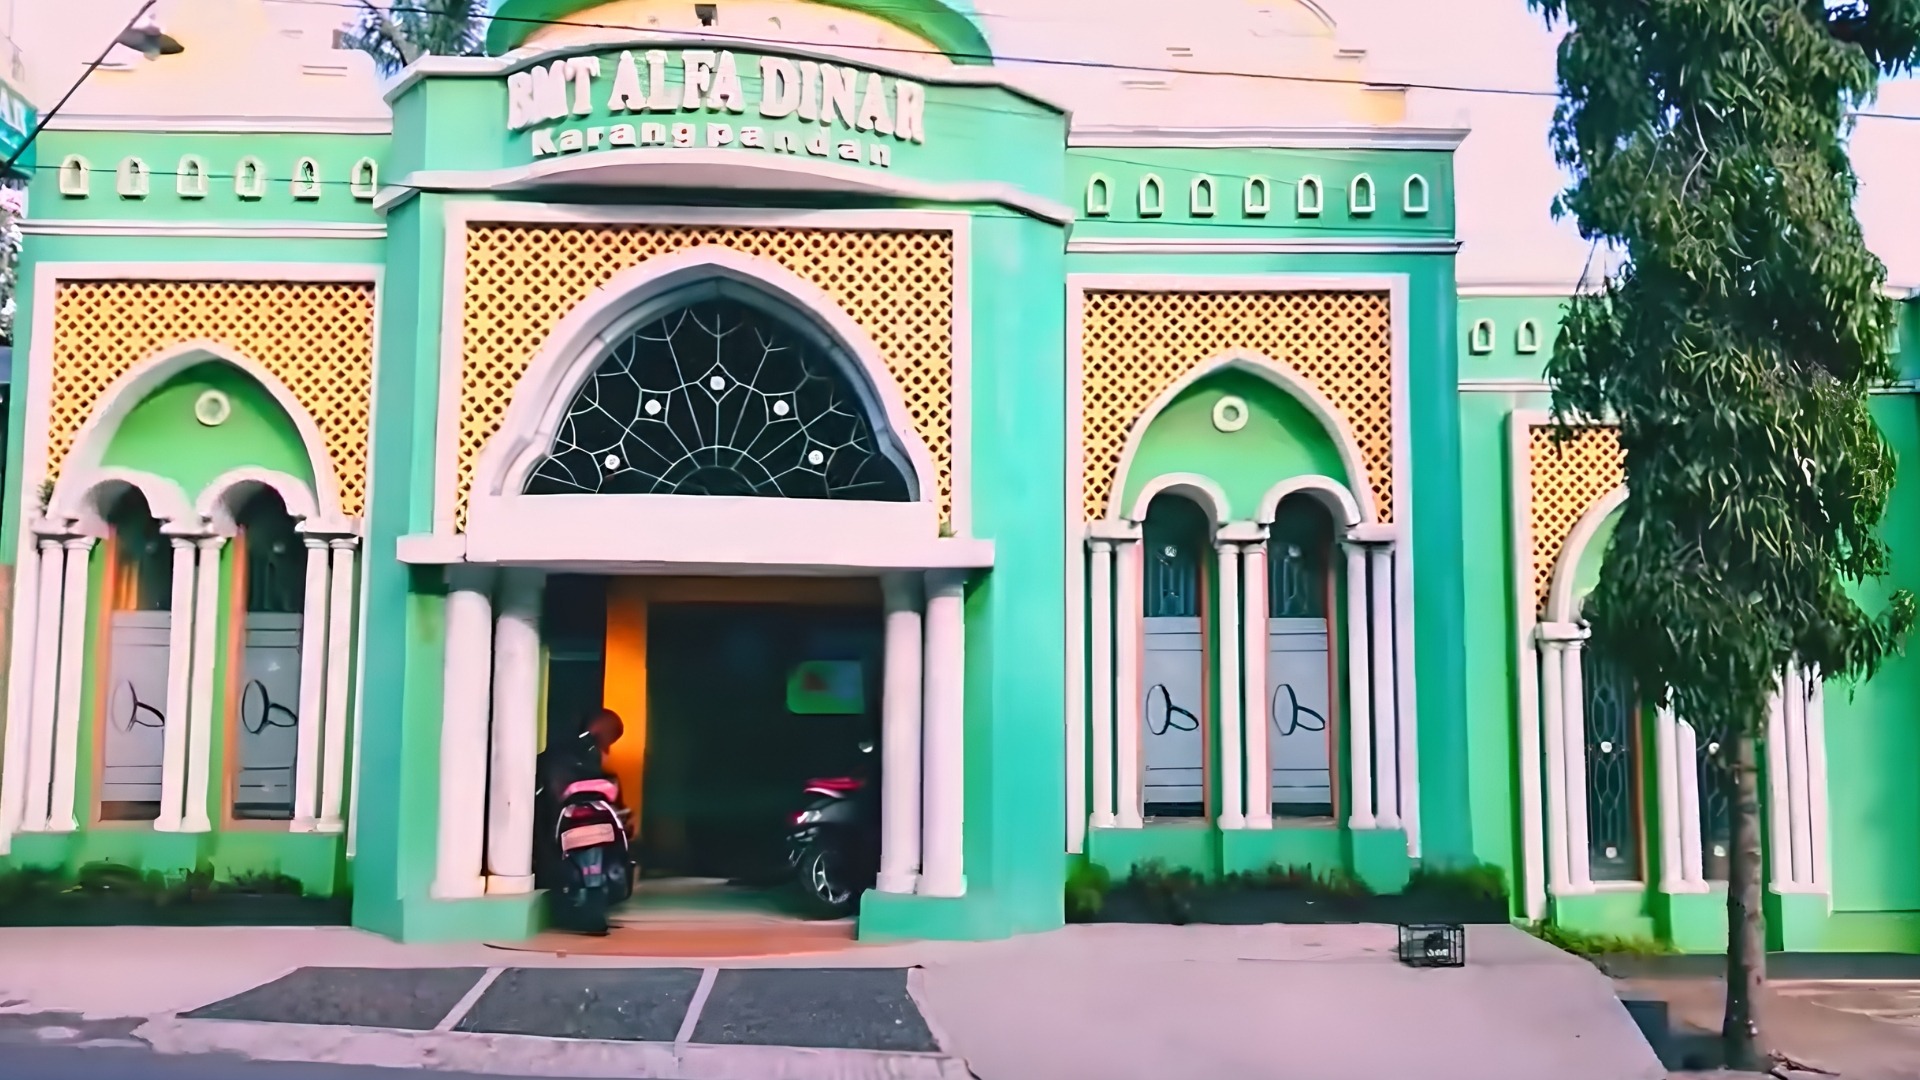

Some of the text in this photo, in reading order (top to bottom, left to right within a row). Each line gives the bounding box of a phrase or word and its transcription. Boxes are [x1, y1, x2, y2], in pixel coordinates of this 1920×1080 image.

[508, 50, 926, 144] BMT ALFA DINAR
